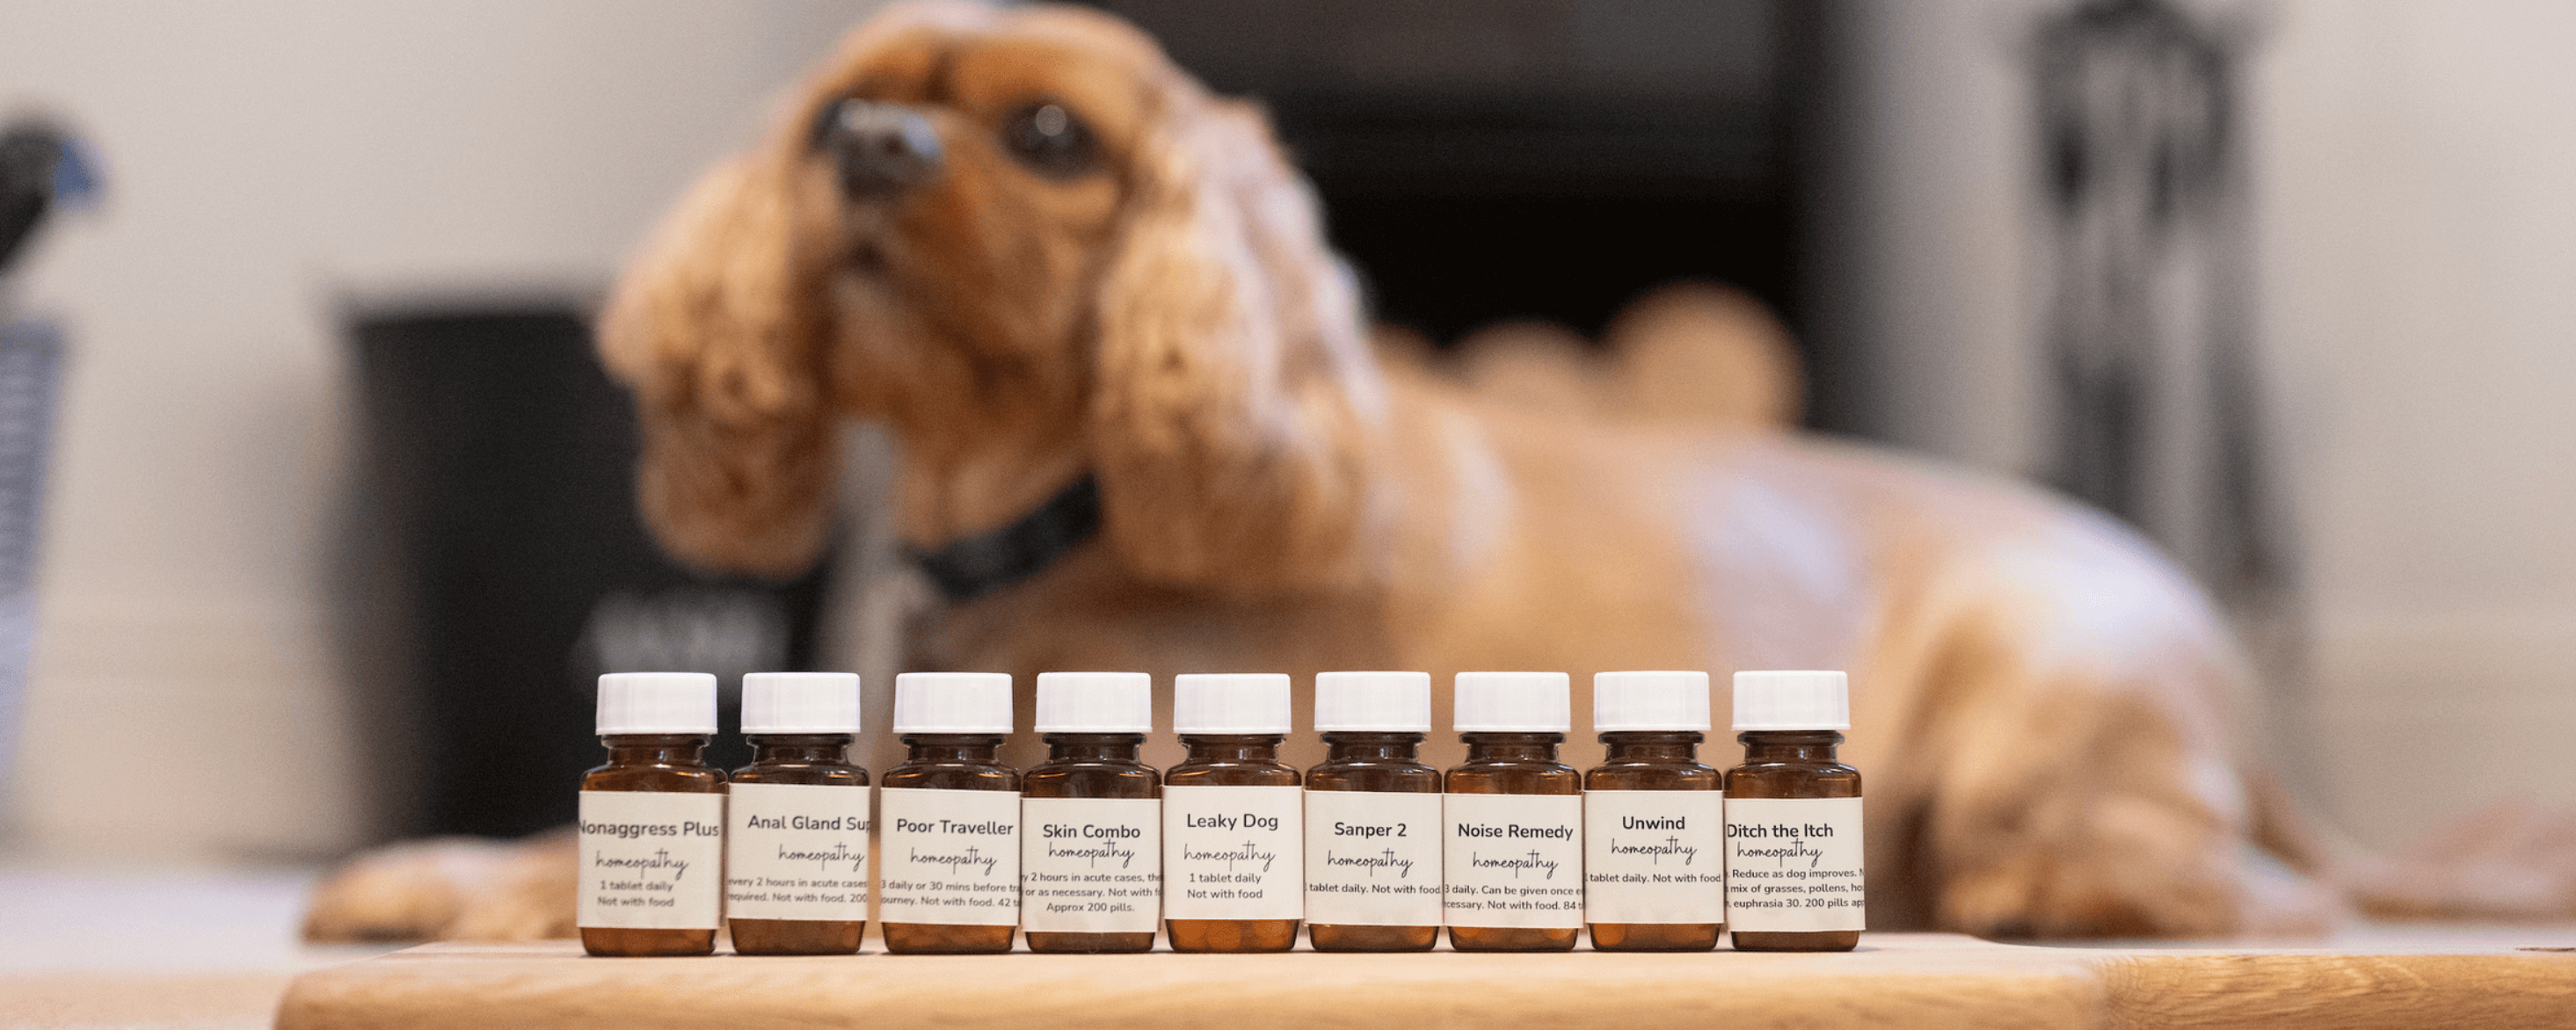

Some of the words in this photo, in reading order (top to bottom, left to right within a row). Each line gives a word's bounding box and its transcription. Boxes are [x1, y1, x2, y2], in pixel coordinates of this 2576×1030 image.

[683, 822, 719, 836] Plus
[748, 815, 787, 829] Anal
[792, 816, 840, 830] Gland
[897, 818, 935, 832] Poor
[940, 820, 1013, 835] Traveller
[1188, 813, 1237, 831] Leaky
[1243, 813, 1277, 831] Dog
[1623, 816, 1685, 830] Unwind
[1044, 824, 1077, 838] Skin
[1083, 824, 1140, 838] Combo
[1335, 822, 1392, 839] Sanper
[1397, 823, 1407, 837] 2
[1459, 823, 1503, 838] Noise
[1509, 824, 1573, 841] Remedy
[1728, 824, 1766, 838] Ditch
[1772, 824, 1799, 837] the
[1805, 823, 1833, 837] Itch
[779, 842, 864, 872] homeopathy
[1049, 839, 1134, 868] homeopathy
[1184, 840, 1276, 872] homeopathy
[1612, 836, 1697, 866] homeopathy
[1737, 838, 1823, 867] homeopathy
[595, 848, 688, 881] homeopathy
[911, 845, 997, 875] homeopathy
[1328, 848, 1413, 878] homeopathy
[1473, 849, 1558, 879] homeopathy
[1031, 873, 1037, 881] 2
[1040, 873, 1068, 881] hours
[1072, 873, 1080, 881] in
[1115, 874, 1145, 883] cases,
[1190, 874, 1195, 882] 1
[1199, 874, 1231, 882] tablet
[1235, 874, 1261, 884] daily
[1590, 874, 1619, 882] tablet
[1622, 874, 1649, 884] daily.
[1653, 874, 1671, 882] Not
[1675, 874, 1697, 882] with
[1786, 870, 1806, 880] dog
[1809, 868, 1856, 879] improves.
[600, 881, 606, 889] 1
[609, 881, 643, 890] tablet
[645, 881, 673, 892] daily
[757, 877, 762, 886] 2
[766, 878, 795, 887] hours
[798, 878, 807, 887] in
[811, 879, 838, 888] acute
[889, 881, 913, 891] daily
[929, 881, 942, 890] 30
[946, 882, 970, 891] mins
[973, 883, 1006, 892] before
[1310, 883, 1338, 892] tablet
[1342, 884, 1368, 895] daily.
[1394, 885, 1415, 894] with
[1765, 885, 1806, 895] grasses,
[1809, 884, 1848, 894] pollens,
[1187, 889, 1207, 898] Not
[1211, 889, 1234, 898] with
[1238, 889, 1263, 898] food
[1452, 885, 1478, 896] daily.
[1481, 885, 1501, 894] Can
[1505, 886, 1517, 895] be
[1520, 886, 1547, 896] given
[598, 897, 616, 906] Not
[621, 897, 644, 906] with
[649, 897, 674, 906] food
[773, 893, 790, 902] Not
[820, 894, 846, 903] food.
[881, 896, 917, 906] ourney.
[921, 896, 939, 905] Not
[942, 897, 965, 906] with
[969, 897, 994, 906] food.
[1734, 899, 1783, 909] euphrasia
[1806, 898, 1824, 907] 200
[1828, 898, 1849, 908] pills
[1046, 903, 1084, 913] Approx
[1088, 903, 1107, 911] 200
[1110, 903, 1134, 913] pills.
[1510, 901, 1532, 910] with
